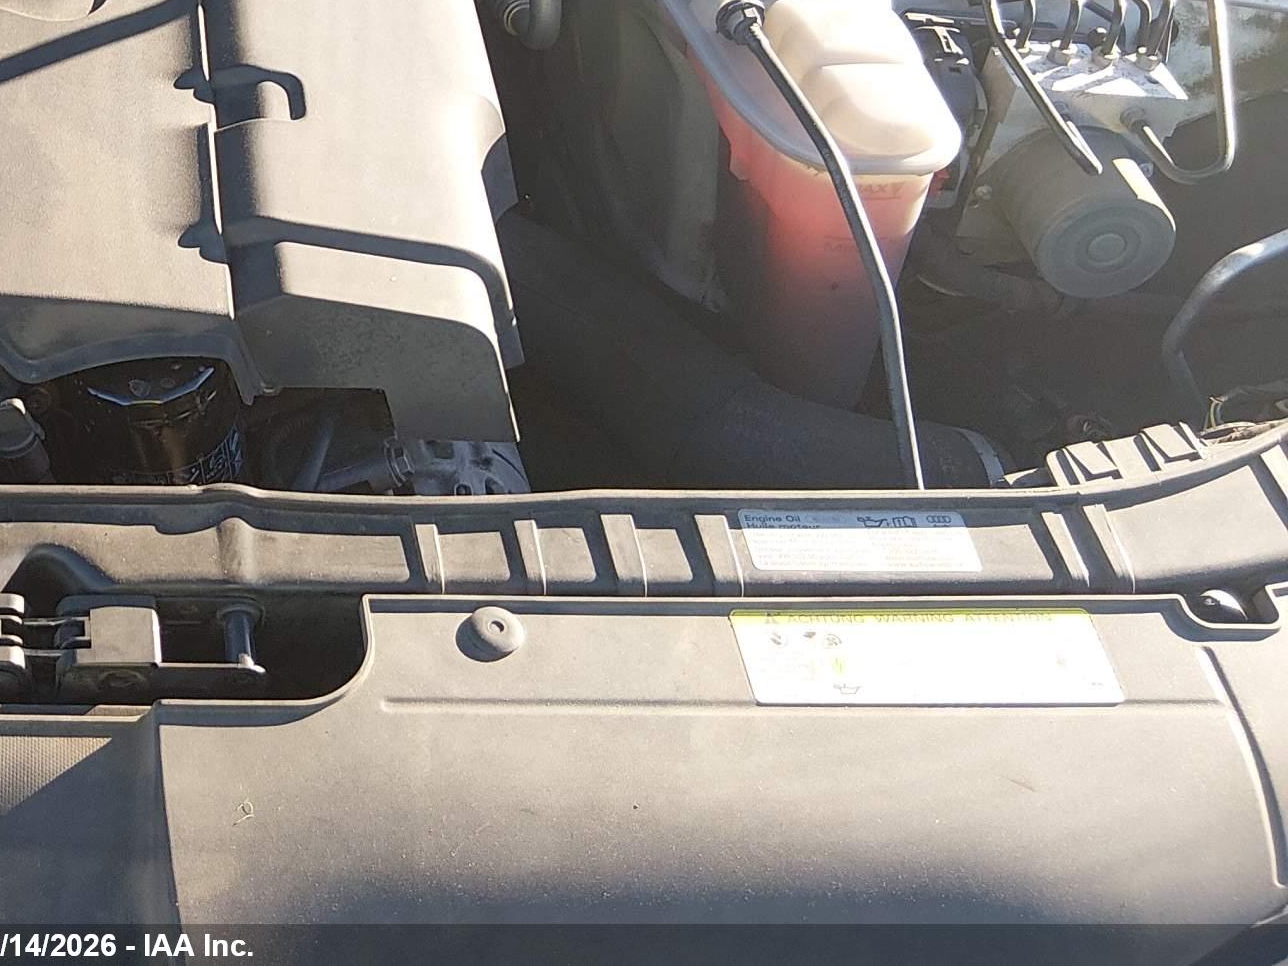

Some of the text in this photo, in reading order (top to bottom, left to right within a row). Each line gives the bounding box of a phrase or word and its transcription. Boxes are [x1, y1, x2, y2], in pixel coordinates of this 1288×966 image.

[744, 514, 783, 523] Engine
[785, 514, 800, 522] Oil
[787, 612, 864, 624] ACHTUNG
[873, 611, 954, 624] WARNING
